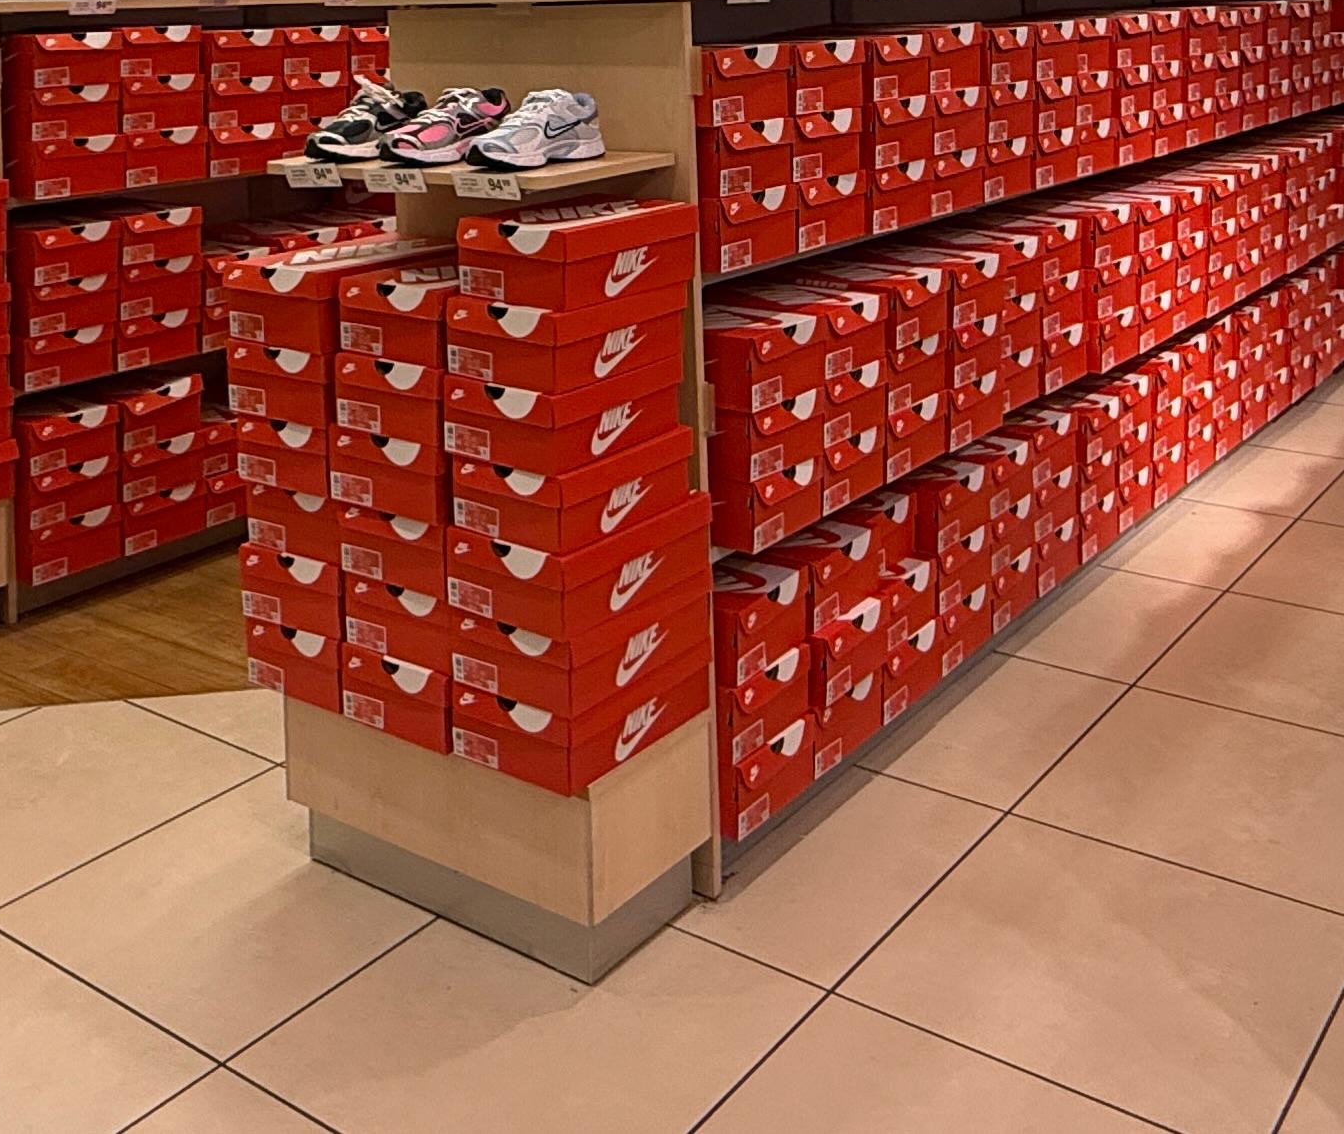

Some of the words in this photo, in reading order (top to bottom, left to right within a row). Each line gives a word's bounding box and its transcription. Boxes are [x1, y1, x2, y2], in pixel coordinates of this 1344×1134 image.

[520, 199, 641, 223] NIKE
[401, 266, 457, 283] NI
[612, 246, 648, 276] NIKE
[601, 324, 638, 357] NIKE
[598, 401, 633, 434] NIKE
[607, 476, 642, 511] NIKE
[618, 550, 654, 589] NIKE
[623, 622, 659, 663] NIKE
[622, 697, 658, 739] NIKE
